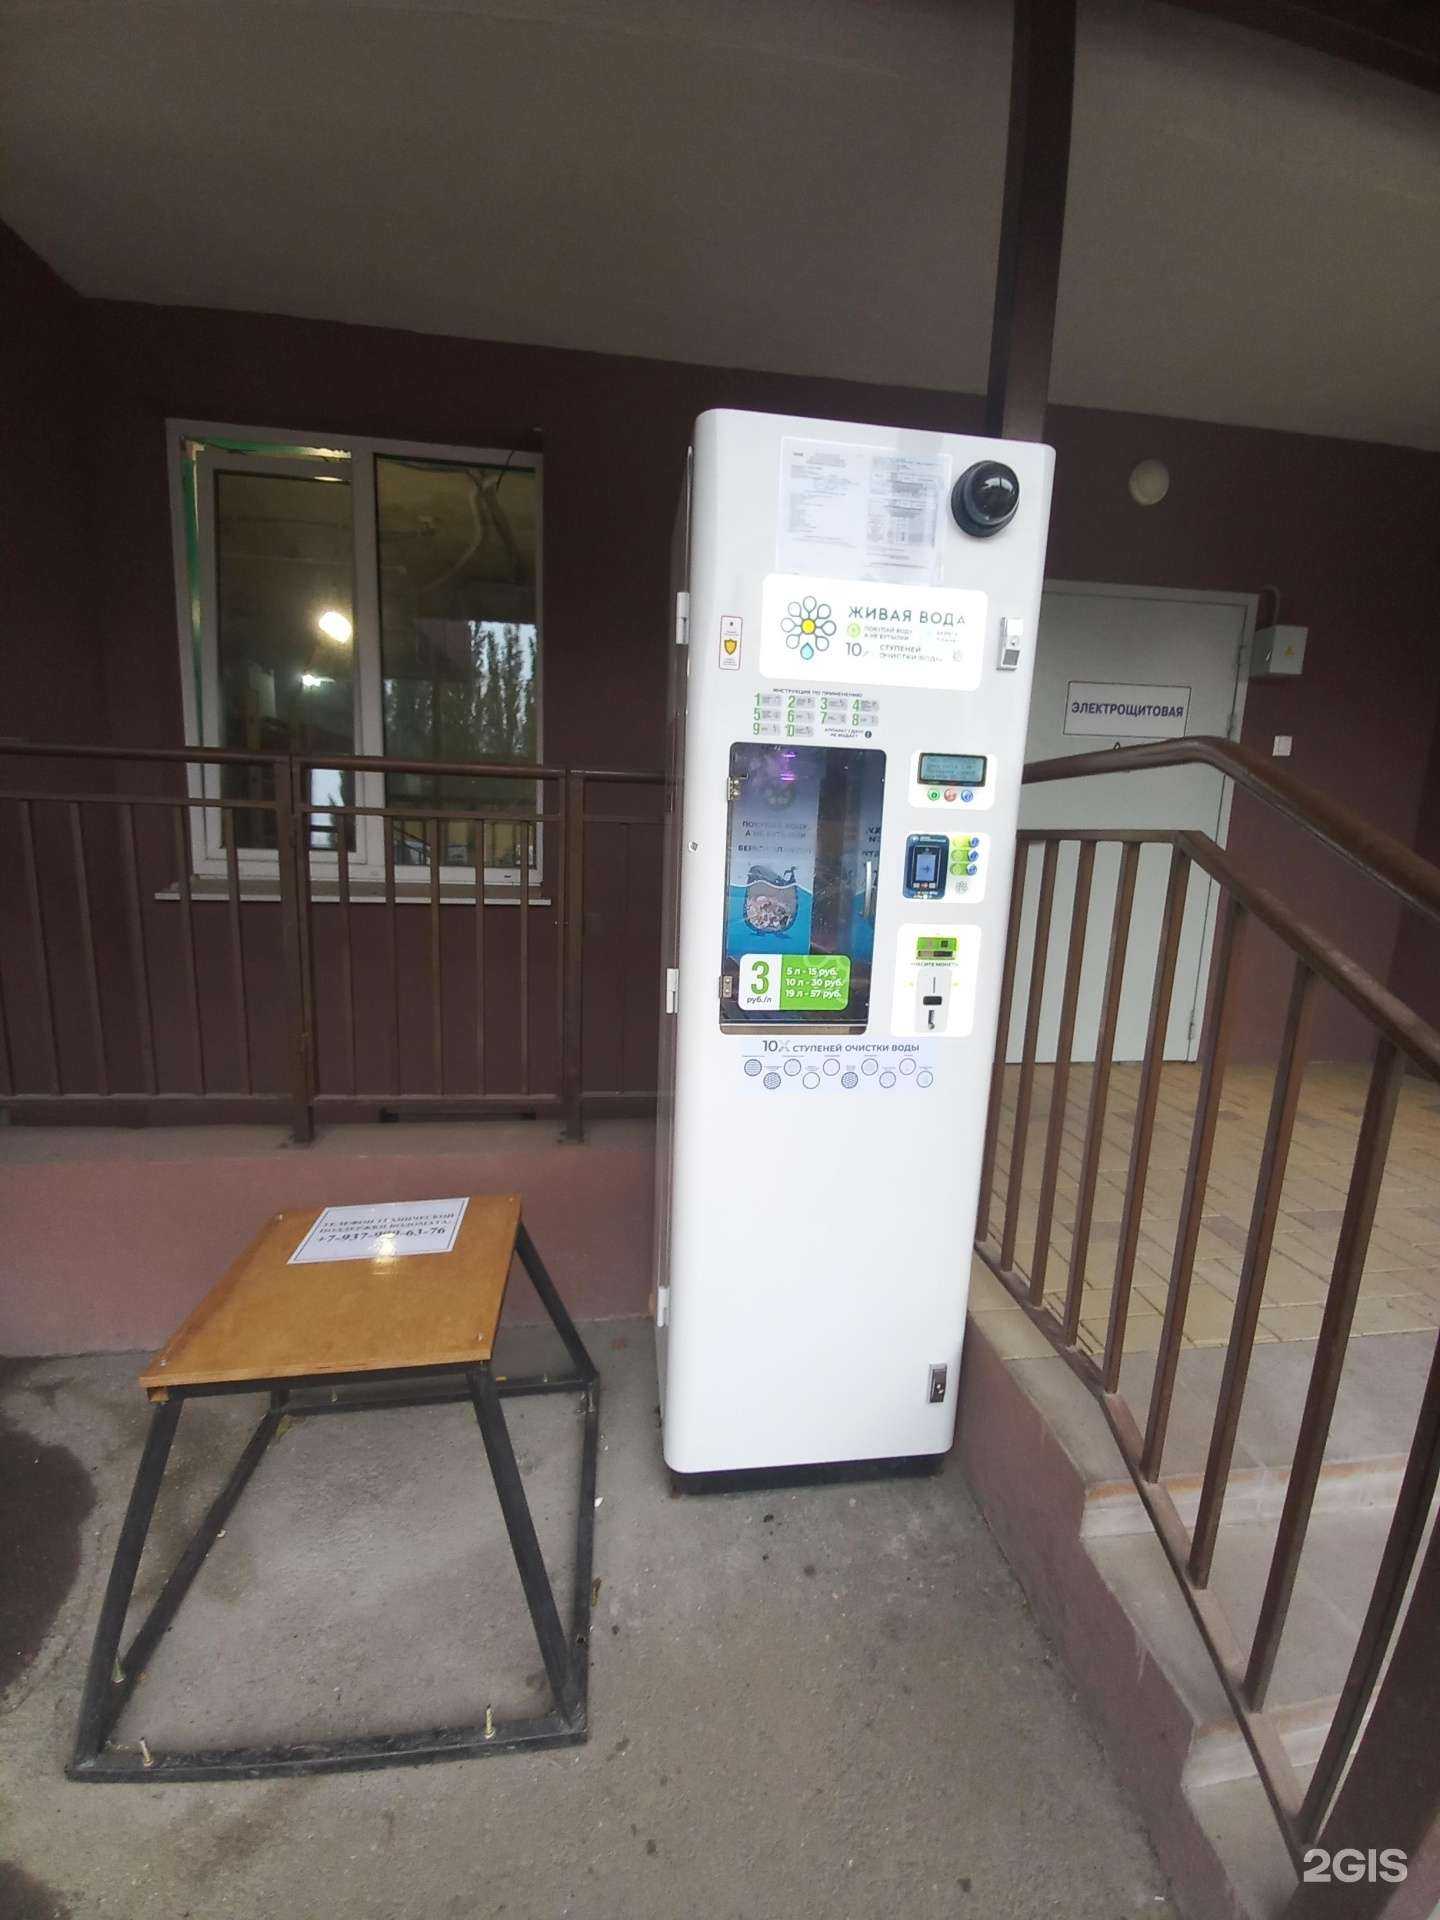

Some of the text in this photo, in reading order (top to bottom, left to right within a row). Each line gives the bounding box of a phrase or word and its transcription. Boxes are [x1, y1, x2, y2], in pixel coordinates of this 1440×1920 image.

[849, 606, 966, 627] ЖИВАЯ ВОДА
[880, 644, 921, 652] СТУПЕНЕЙ
[788, 695, 796, 709] 2
[820, 697, 828, 711] 3
[852, 699, 860, 712] 4
[753, 708, 761, 721] 5
[787, 710, 795, 723] 6
[1071, 702, 1184, 718] ЭЛЕКТРОЩИТОВАЯ
[820, 711, 828, 725] 7
[852, 713, 860, 727] 8
[752, 723, 760, 736] 9
[751, 961, 770, 995] 3
[786, 967, 792, 976] 5
[793, 968, 801, 976] л
[808, 967, 817, 977] 15
[818, 968, 838, 979] руб.
[811, 978, 823, 987] 30
[824, 979, 844, 990] руб.
[747, 996, 772, 1004] руб./л
[785, 989, 794, 998] 19
[795, 990, 803, 998] л
[810, 989, 822, 998] 57
[822, 989, 842, 1000] руб.
[792, 1044, 842, 1053] СТУПЕНЕЙ
[844, 1044, 889, 1052] ОЧИСТКИ
[891, 1044, 920, 1052] ВОДЫ
